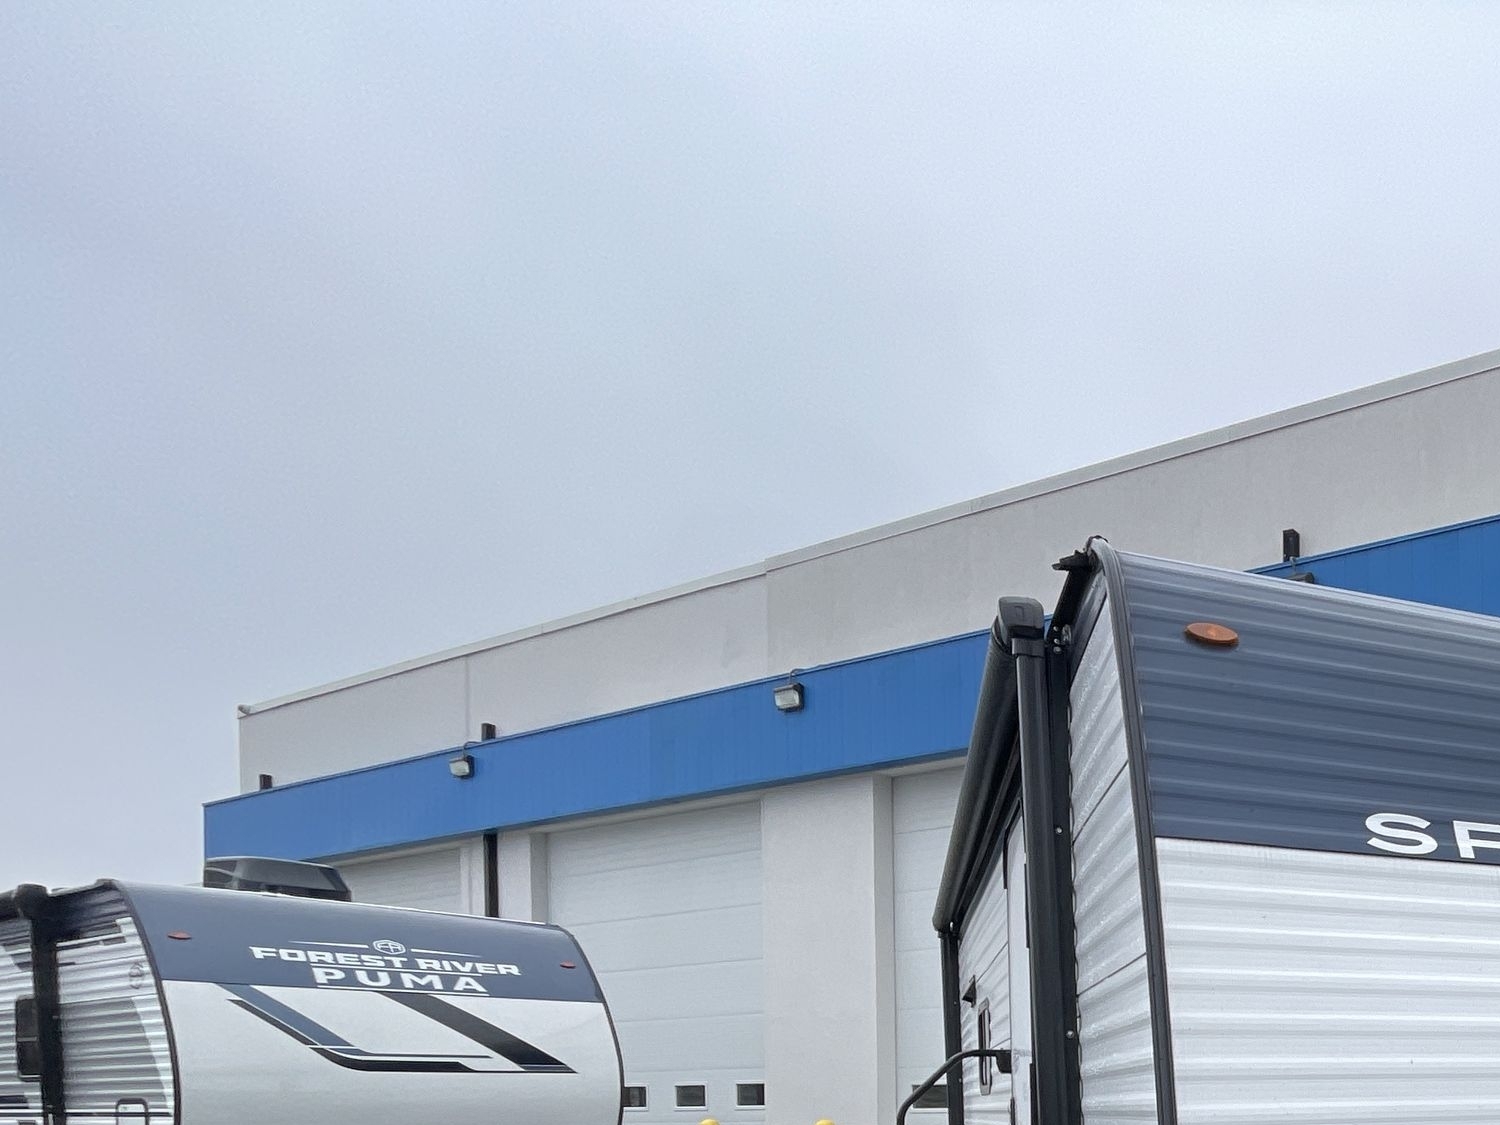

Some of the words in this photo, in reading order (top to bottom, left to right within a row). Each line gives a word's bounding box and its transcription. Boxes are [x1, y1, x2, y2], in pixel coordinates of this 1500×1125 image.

[249, 946, 408, 969] FOREST
[415, 958, 522, 976] RIVER
[311, 967, 488, 993] PUMA
